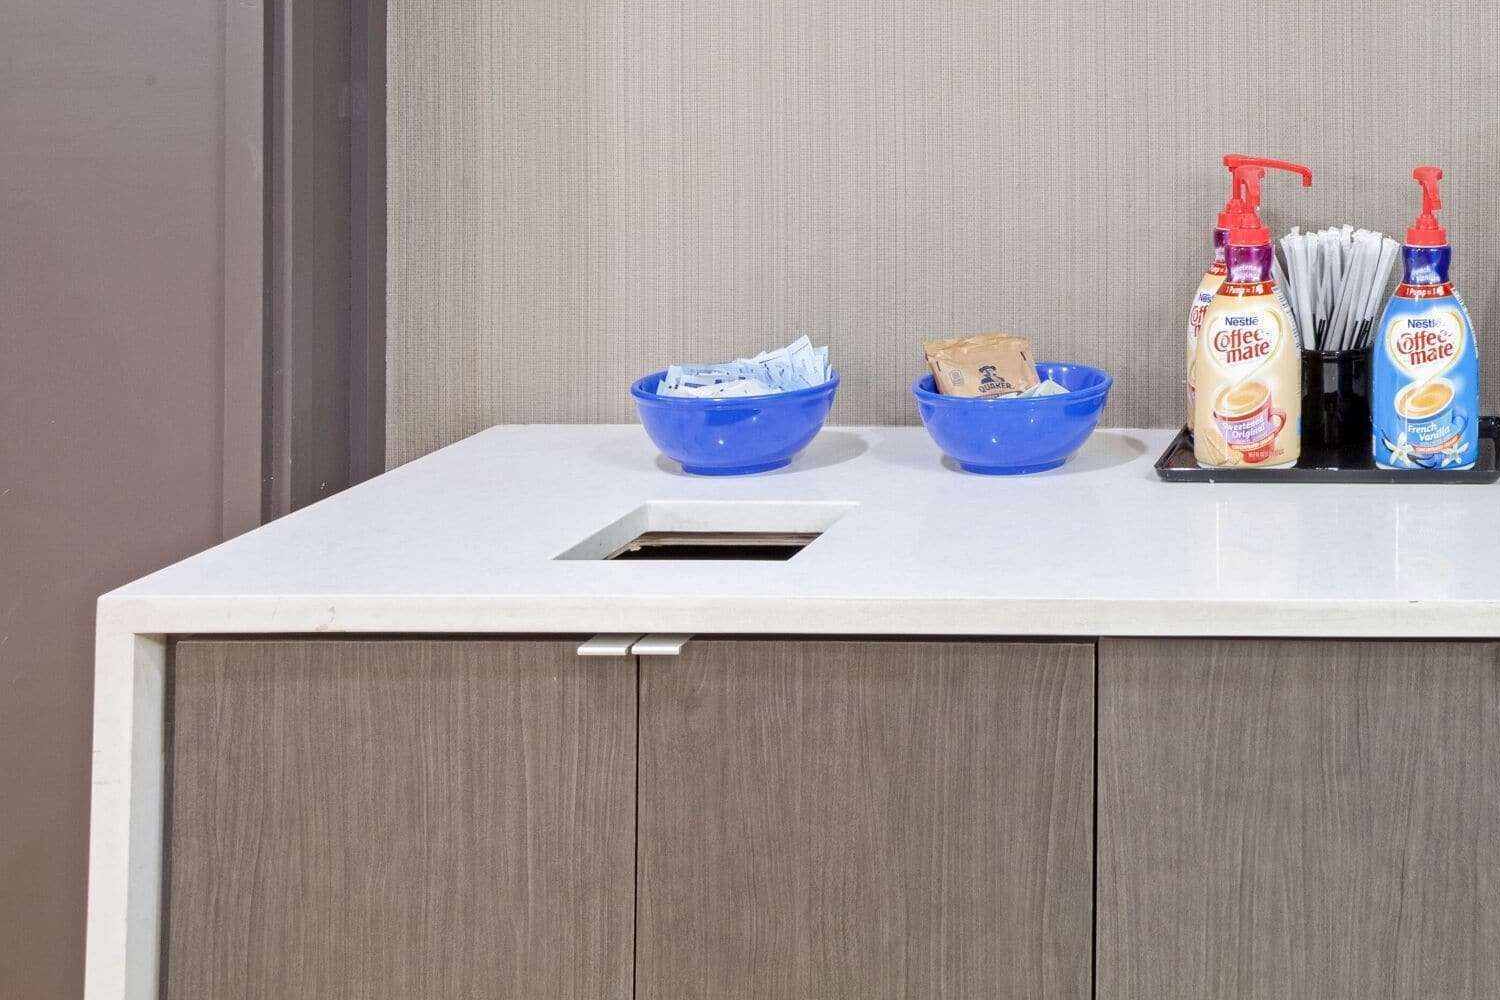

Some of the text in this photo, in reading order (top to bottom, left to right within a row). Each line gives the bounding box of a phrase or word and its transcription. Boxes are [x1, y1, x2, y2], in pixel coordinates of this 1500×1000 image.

[1226, 341, 1270, 363] mate
[1410, 343, 1454, 365] mate
[1231, 424, 1266, 439] Original
[1419, 426, 1450, 442] Vanilla
